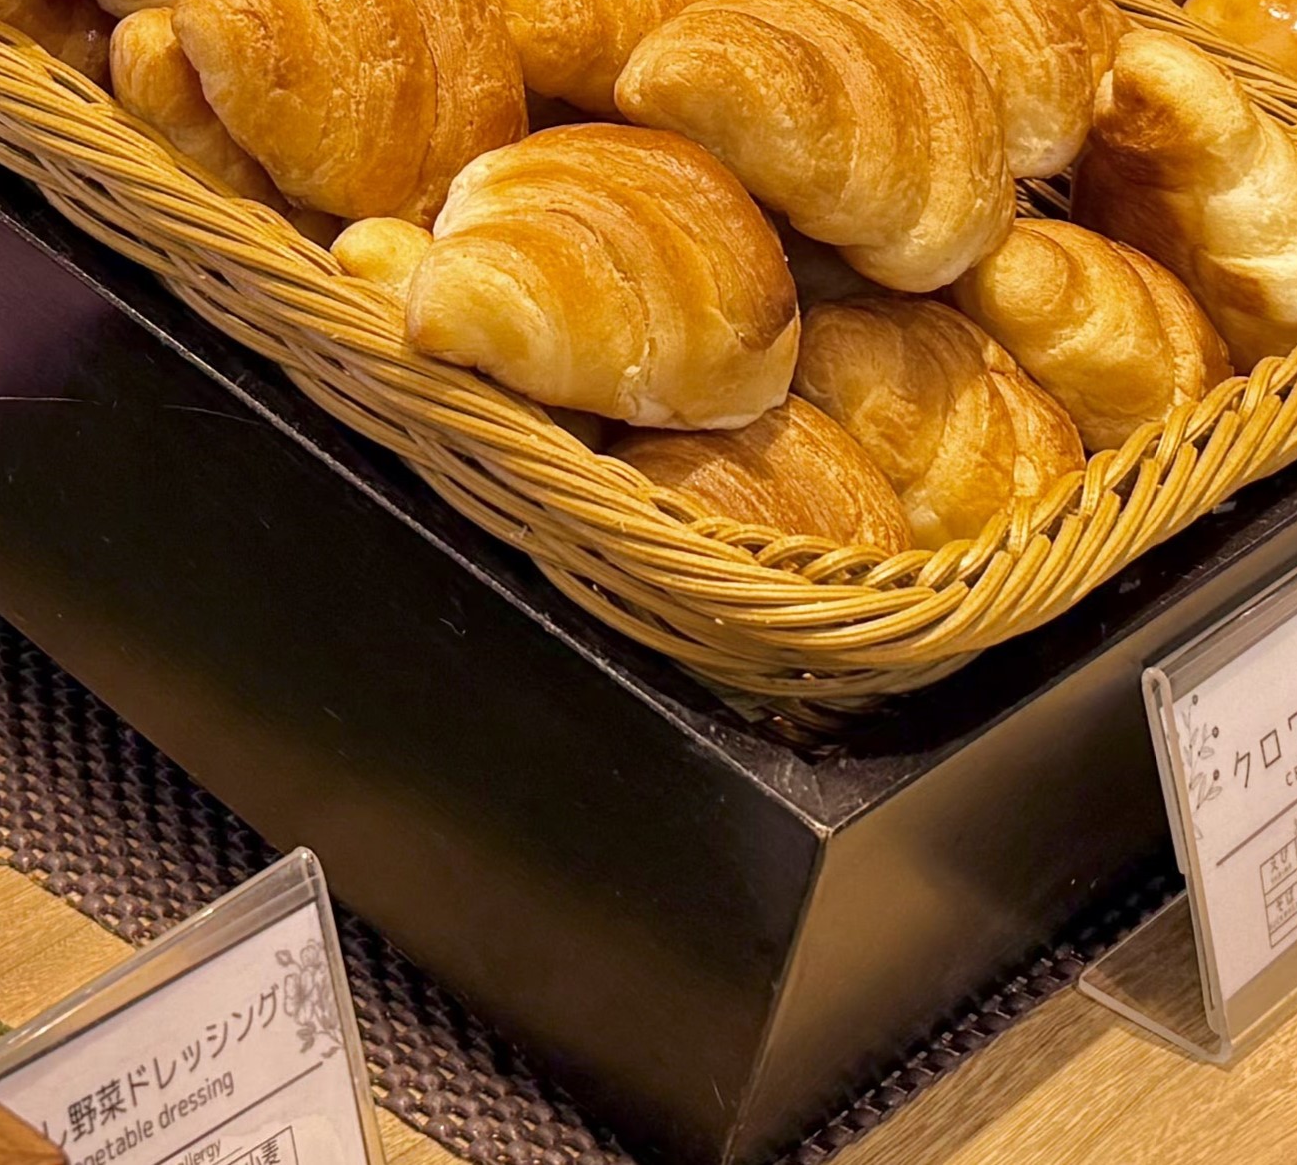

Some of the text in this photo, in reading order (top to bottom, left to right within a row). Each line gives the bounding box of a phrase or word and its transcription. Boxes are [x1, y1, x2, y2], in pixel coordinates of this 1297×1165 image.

[43, 984, 279, 1148] し野菜ドレッシング
[158, 1071, 234, 1129] dressing
